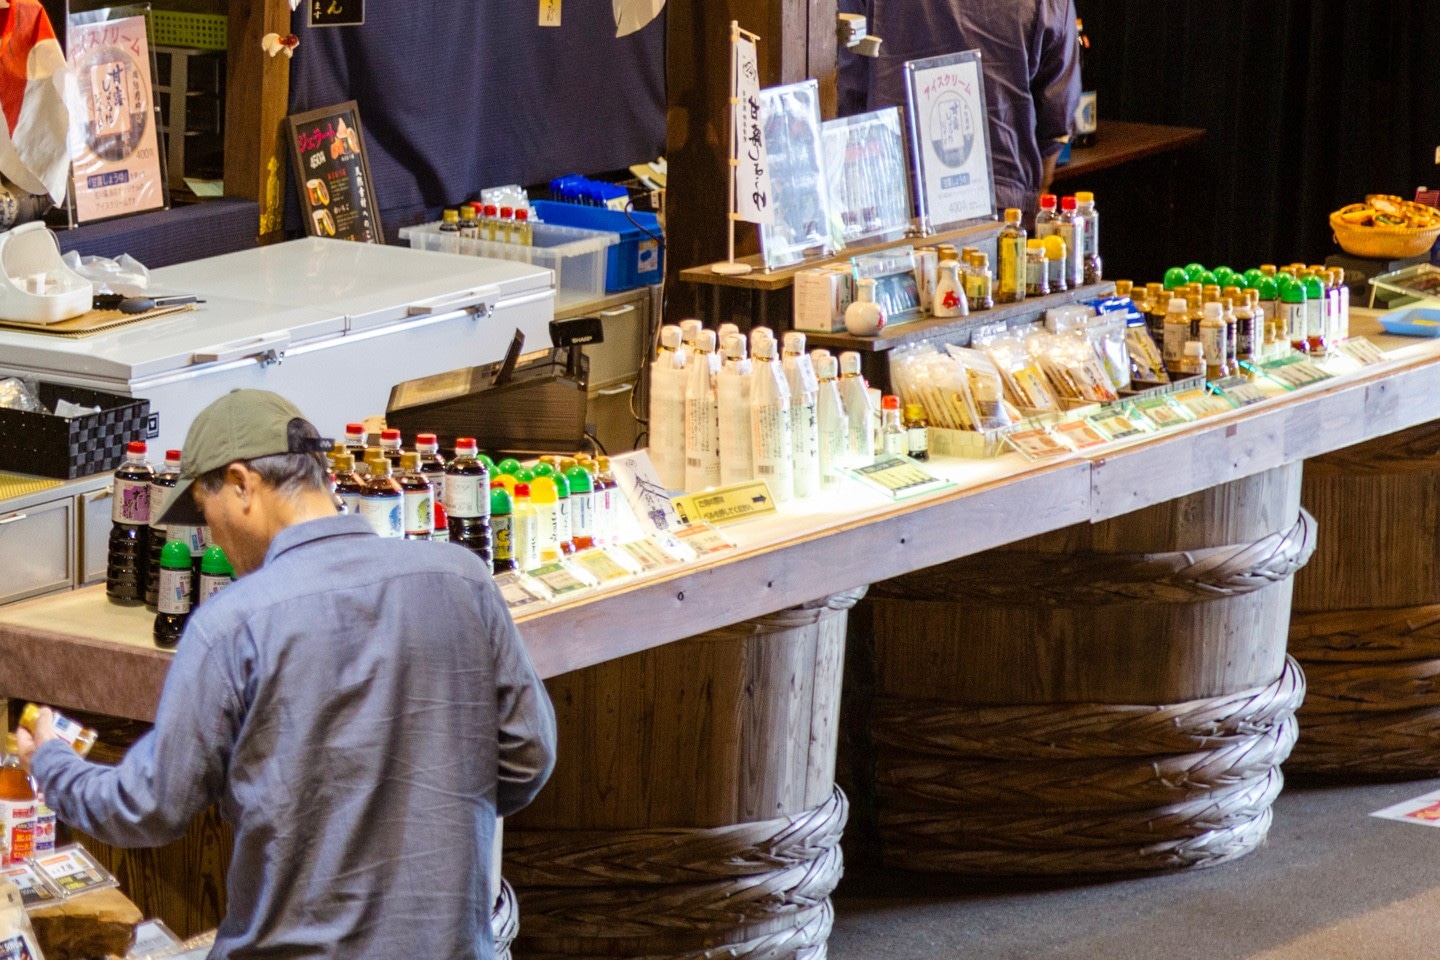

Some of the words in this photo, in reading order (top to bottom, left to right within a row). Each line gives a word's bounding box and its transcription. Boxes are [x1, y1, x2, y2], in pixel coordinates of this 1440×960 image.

[924, 74, 972, 102] アイスクリーム
[571, 335, 593, 344] SHARP
